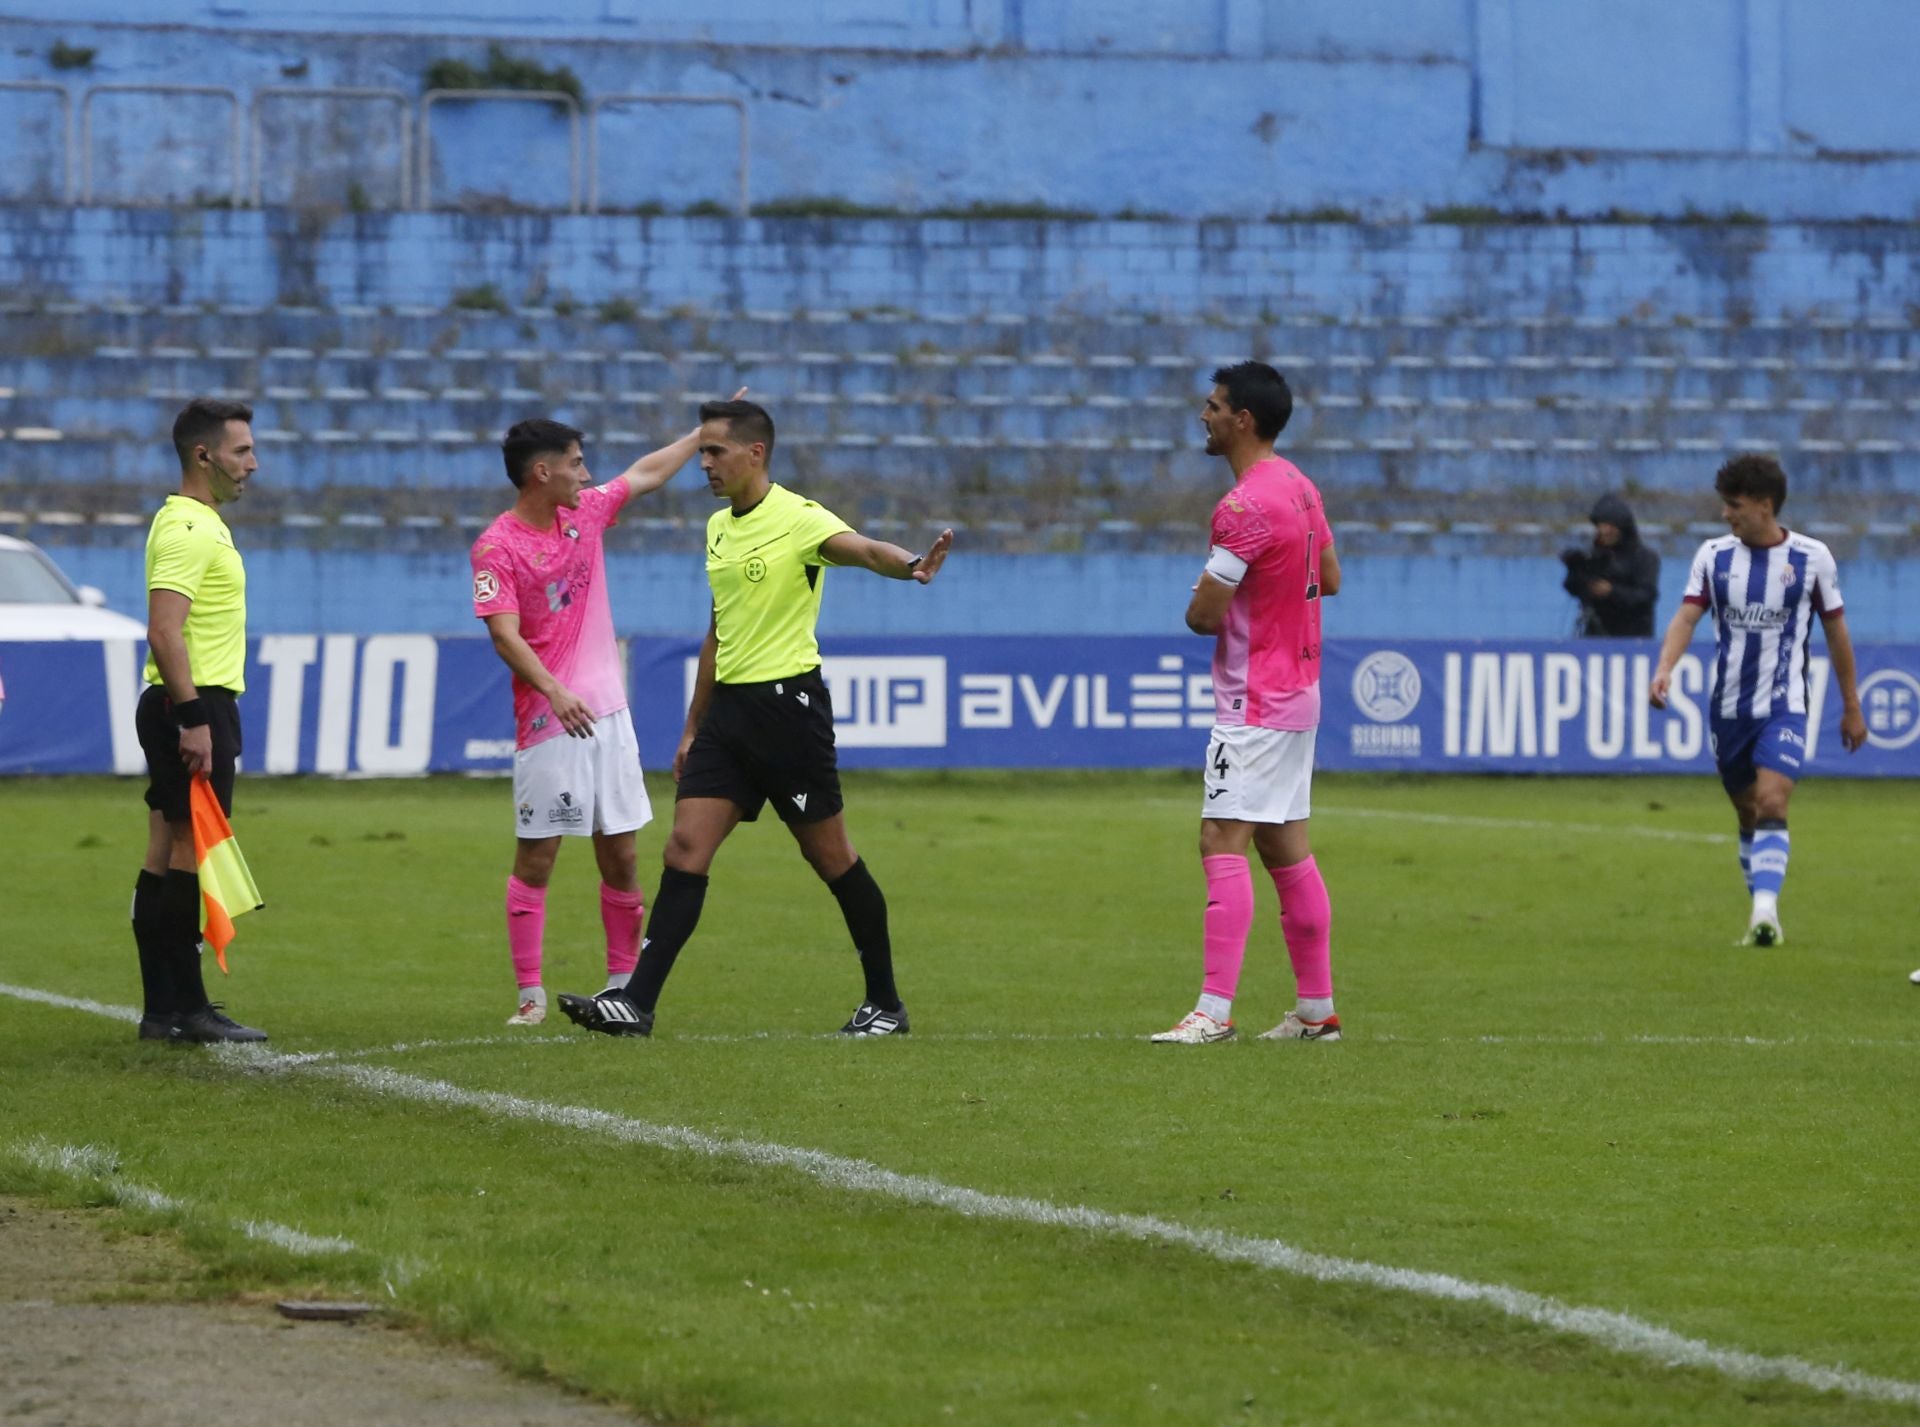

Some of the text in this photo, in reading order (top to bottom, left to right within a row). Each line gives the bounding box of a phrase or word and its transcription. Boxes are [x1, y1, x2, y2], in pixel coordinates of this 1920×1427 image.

[103, 634, 438, 776] VTIO
[1444, 652, 1720, 761] IMPULS
[1214, 742, 1230, 780] 4
